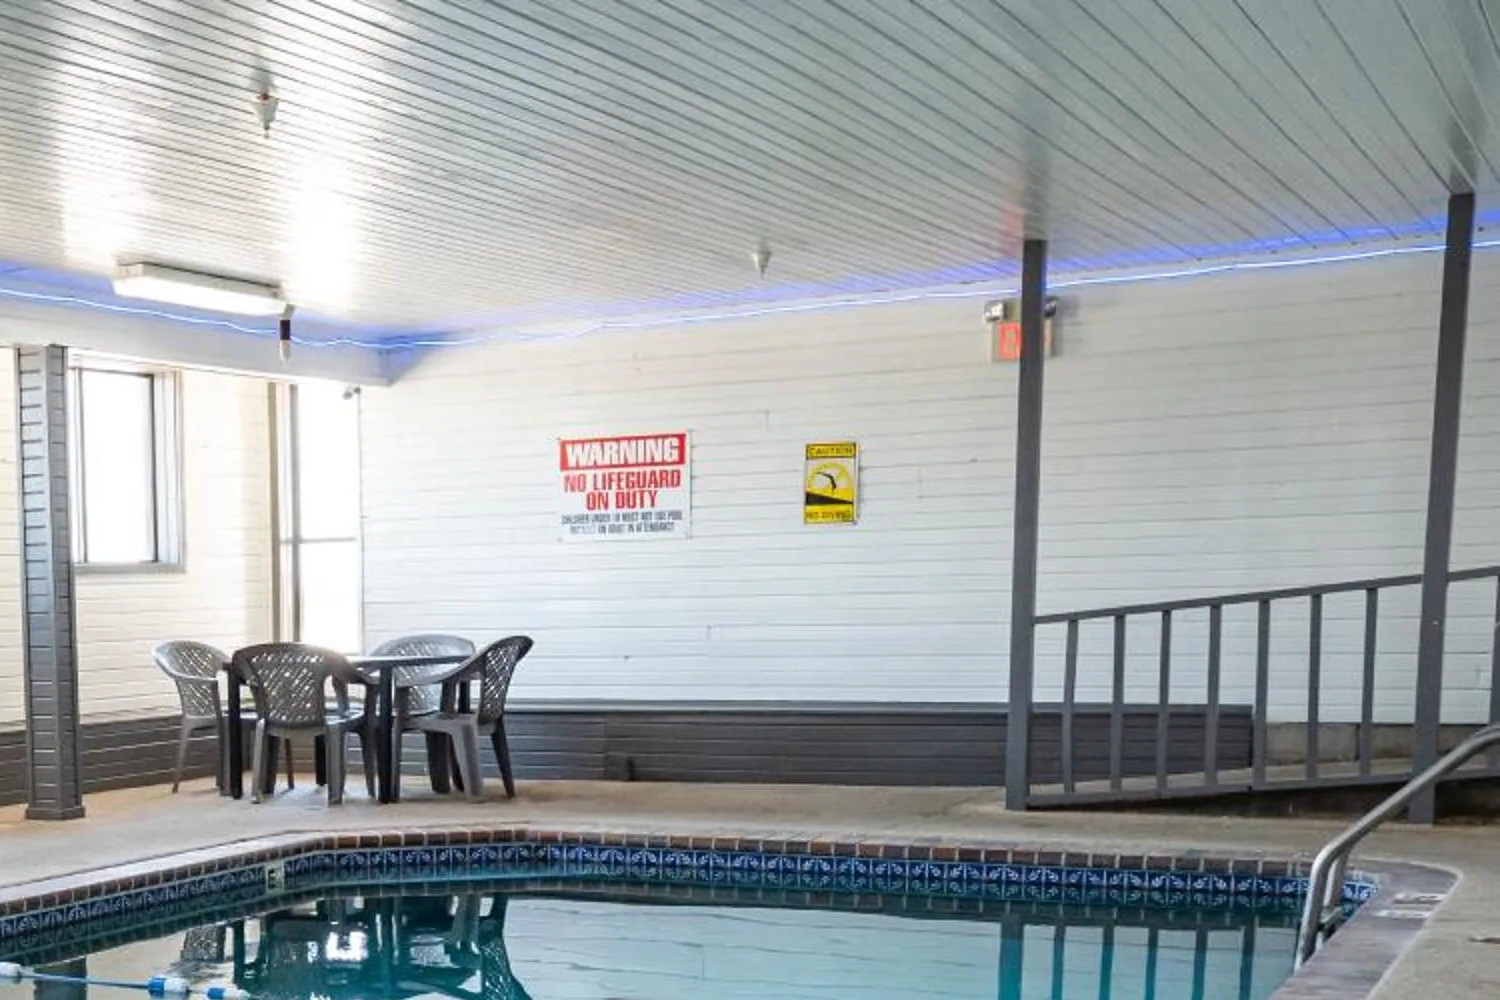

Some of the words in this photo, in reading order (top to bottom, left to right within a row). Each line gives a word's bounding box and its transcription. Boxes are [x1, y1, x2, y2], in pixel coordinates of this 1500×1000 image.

[566, 437, 679, 466] WARNING
[564, 474, 586, 492] NO
[593, 470, 680, 491] LIFEGUARD
[586, 492, 609, 511] ON
[616, 490, 658, 509] DUTY
